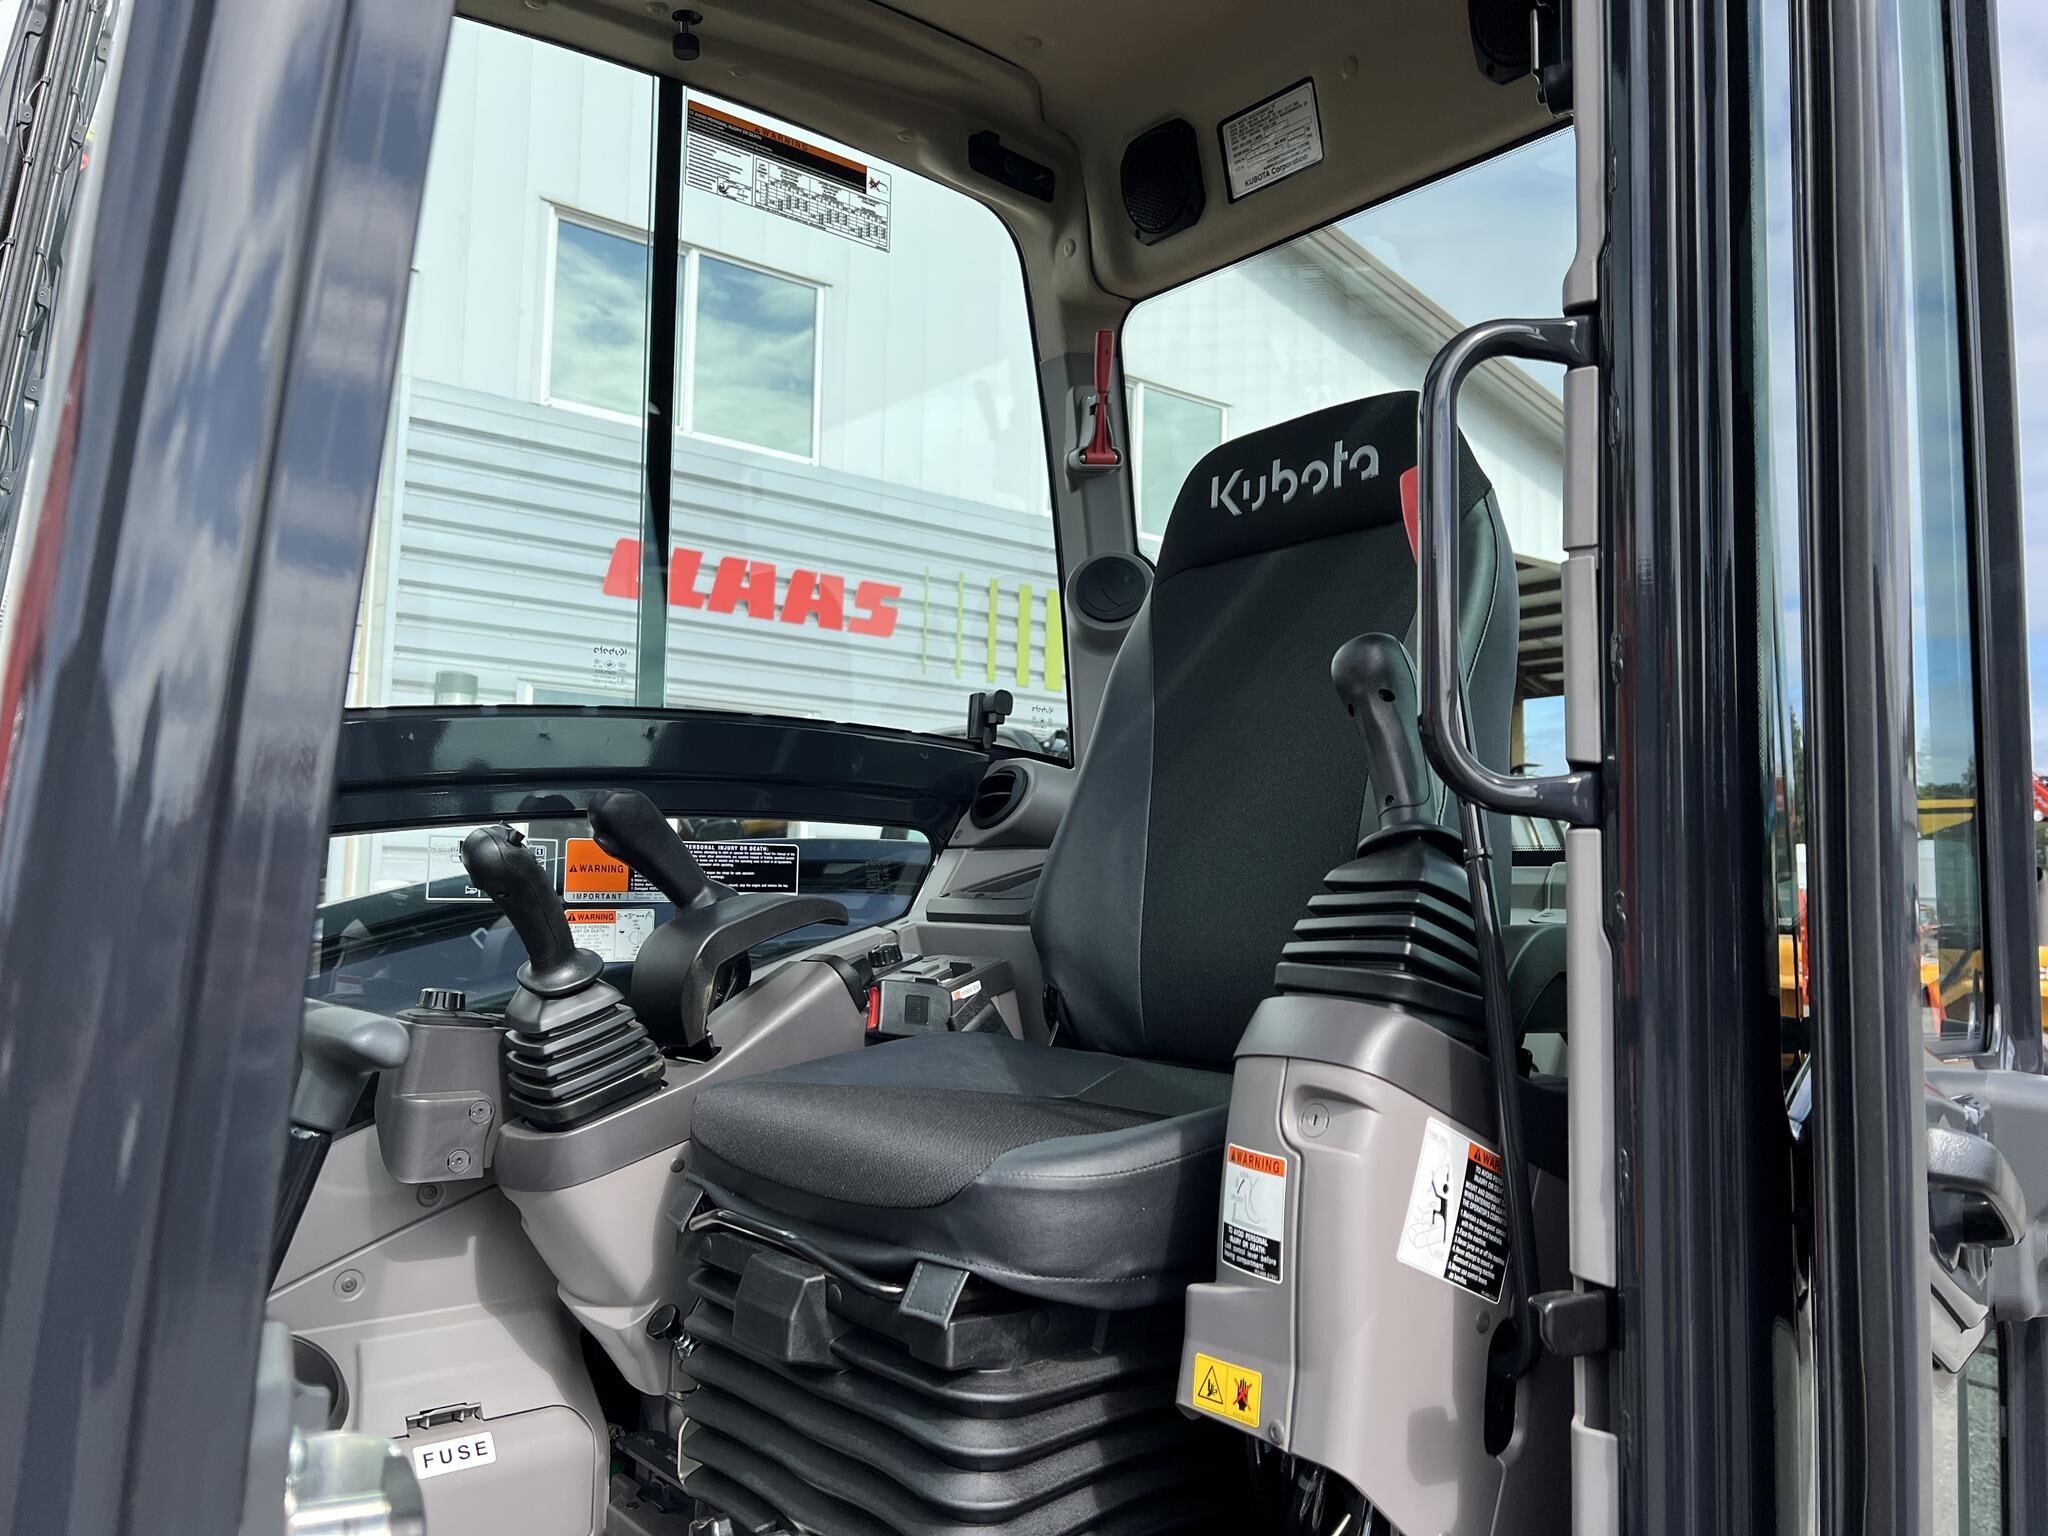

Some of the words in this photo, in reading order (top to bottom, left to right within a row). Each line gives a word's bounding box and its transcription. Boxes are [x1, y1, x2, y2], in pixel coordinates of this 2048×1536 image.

[762, 129, 808, 151] WARNING
[1244, 170, 1270, 187] KUBOTA
[1271, 154, 1308, 175] Corporation
[1210, 439, 1380, 516] Kubota
[603, 538, 902, 638] CLAAS
[579, 864, 624, 874] WARNING
[577, 913, 614, 921] WARNING
[1237, 1151, 1280, 1173] WARNING
[423, 1440, 488, 1469] FUSE
